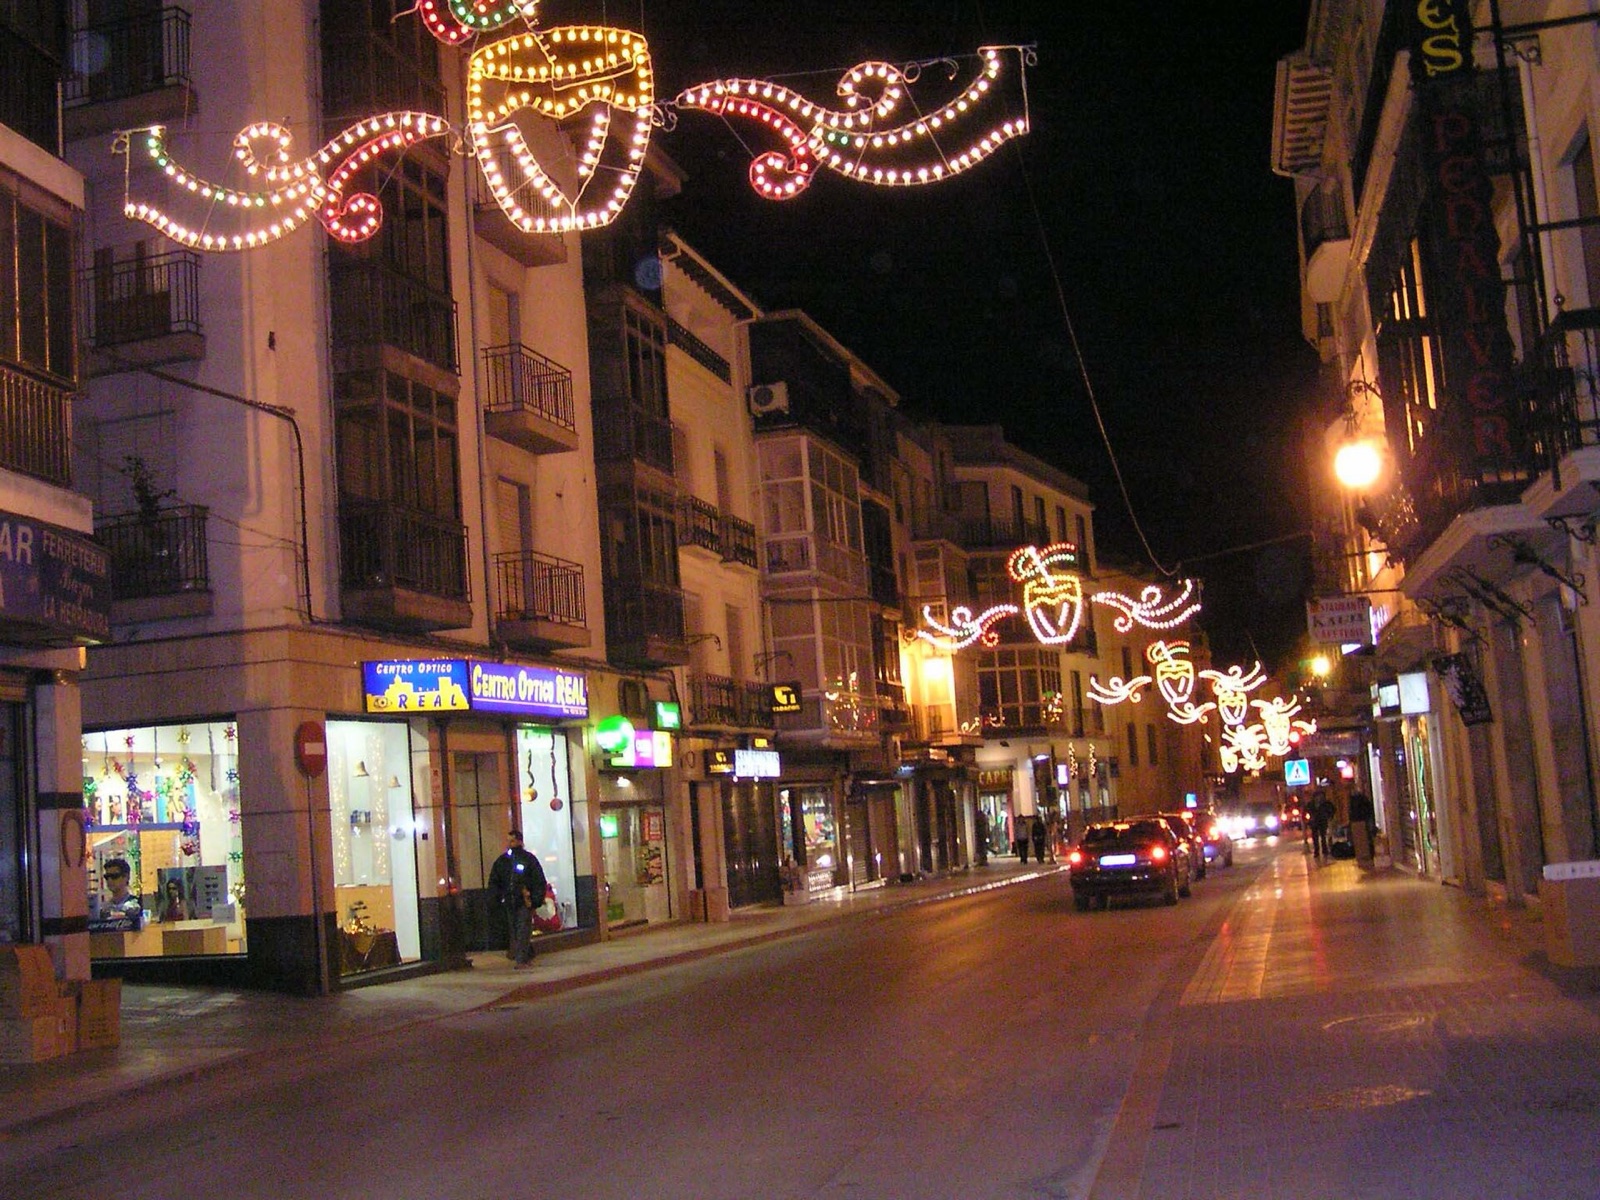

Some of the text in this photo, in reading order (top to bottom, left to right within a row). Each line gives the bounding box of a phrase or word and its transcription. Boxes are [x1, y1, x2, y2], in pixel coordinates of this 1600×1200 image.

[376, 662, 452, 674] CENTRO OPTICO
[473, 664, 586, 707] CENTRO OPTICO REAL
[398, 694, 457, 709] REAL
